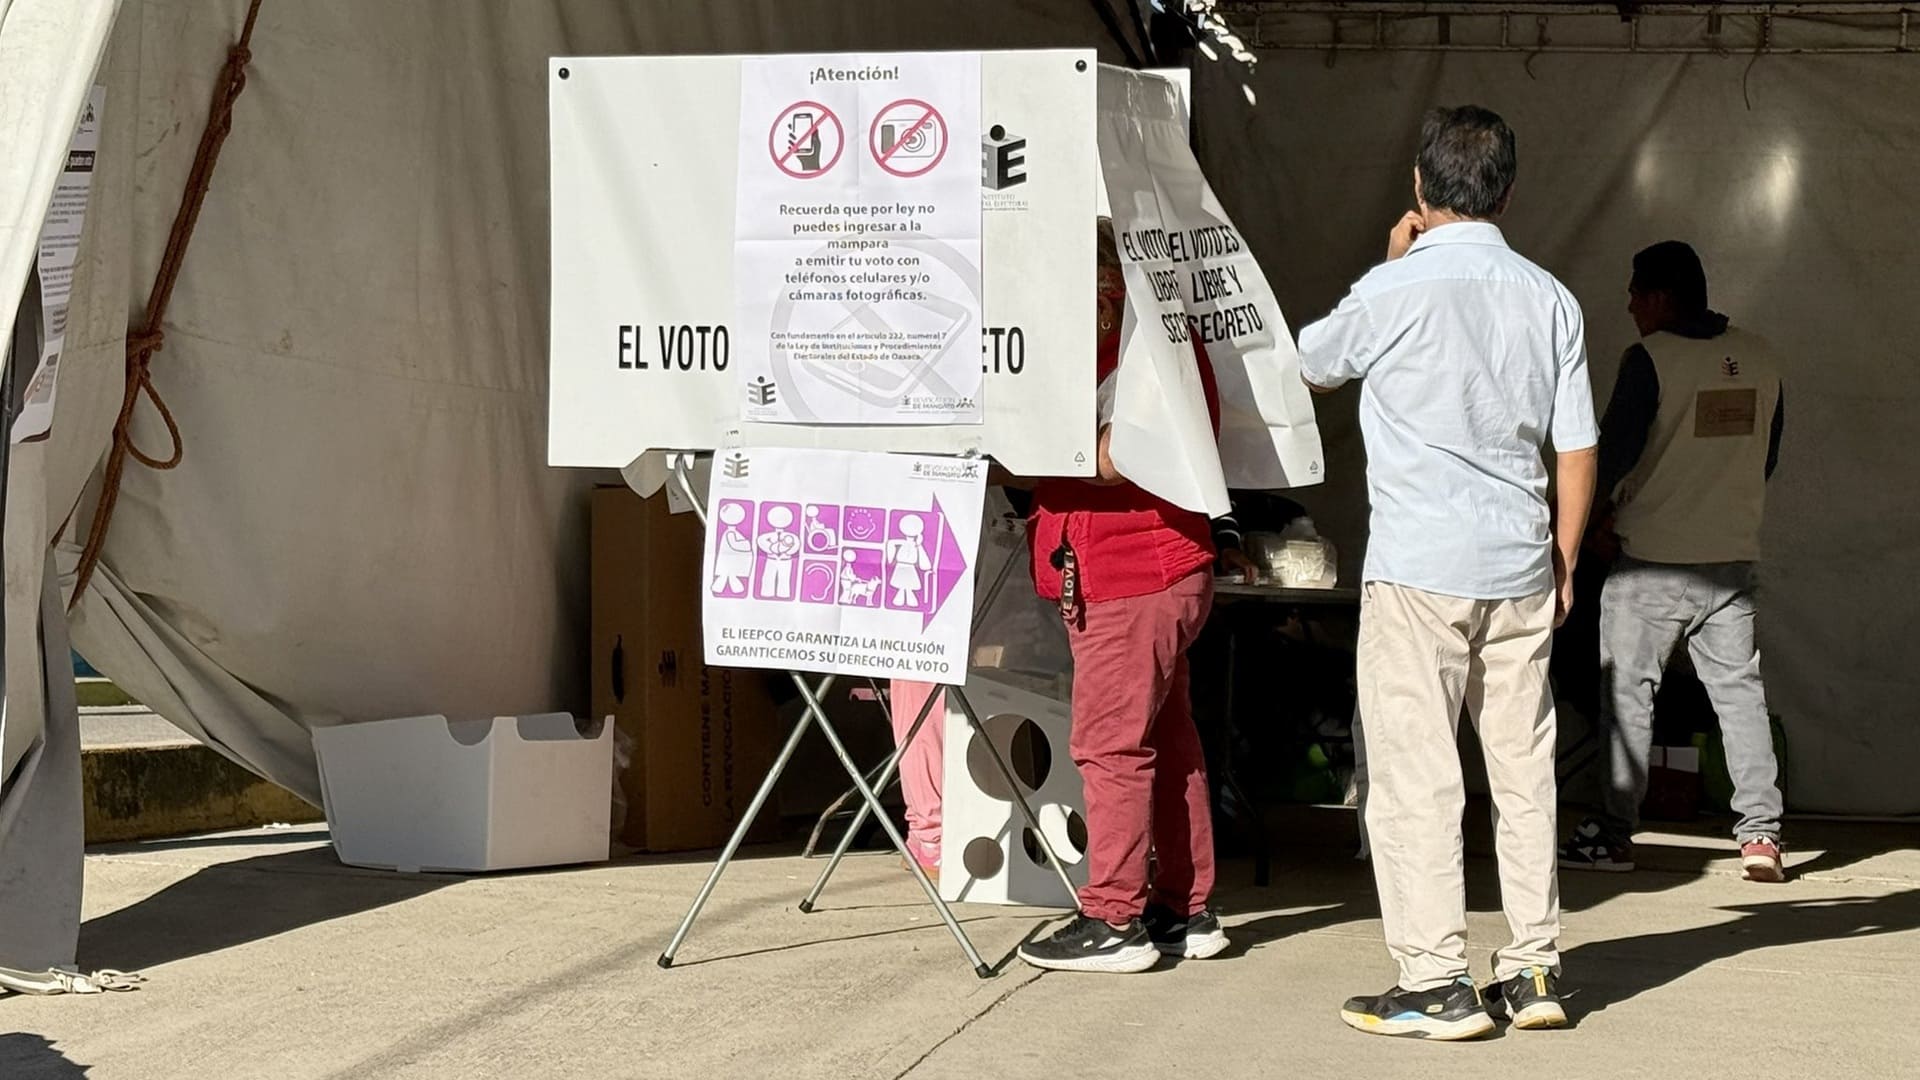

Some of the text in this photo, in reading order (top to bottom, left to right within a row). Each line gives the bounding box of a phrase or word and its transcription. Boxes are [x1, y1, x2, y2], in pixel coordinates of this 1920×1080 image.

[810, 66, 899, 84] ¡Atención!
[780, 204, 934, 217] Recuerda que por ley no
[793, 221, 921, 234] puedes ingresar a la
[827, 241, 888, 251] mampara
[1123, 232, 1142, 261] EL
[1168, 225, 1239, 262] EL VOTO ES
[795, 255, 919, 266] a emitir tu voto con
[785, 272, 930, 285] teléfonos celulares y/o
[1191, 265, 1243, 303] LIBRE Y
[789, 289, 926, 303] cámaras fotográficas.
[619, 325, 729, 371] EL VOTO
[796, 343, 808, 351] Ley
[722, 628, 945, 656] EL IEEPCO GARANTIZA LA INCLUSIÓN
[717, 645, 949, 673] GARANTICEMOS SU DERECHO AL VOTO
